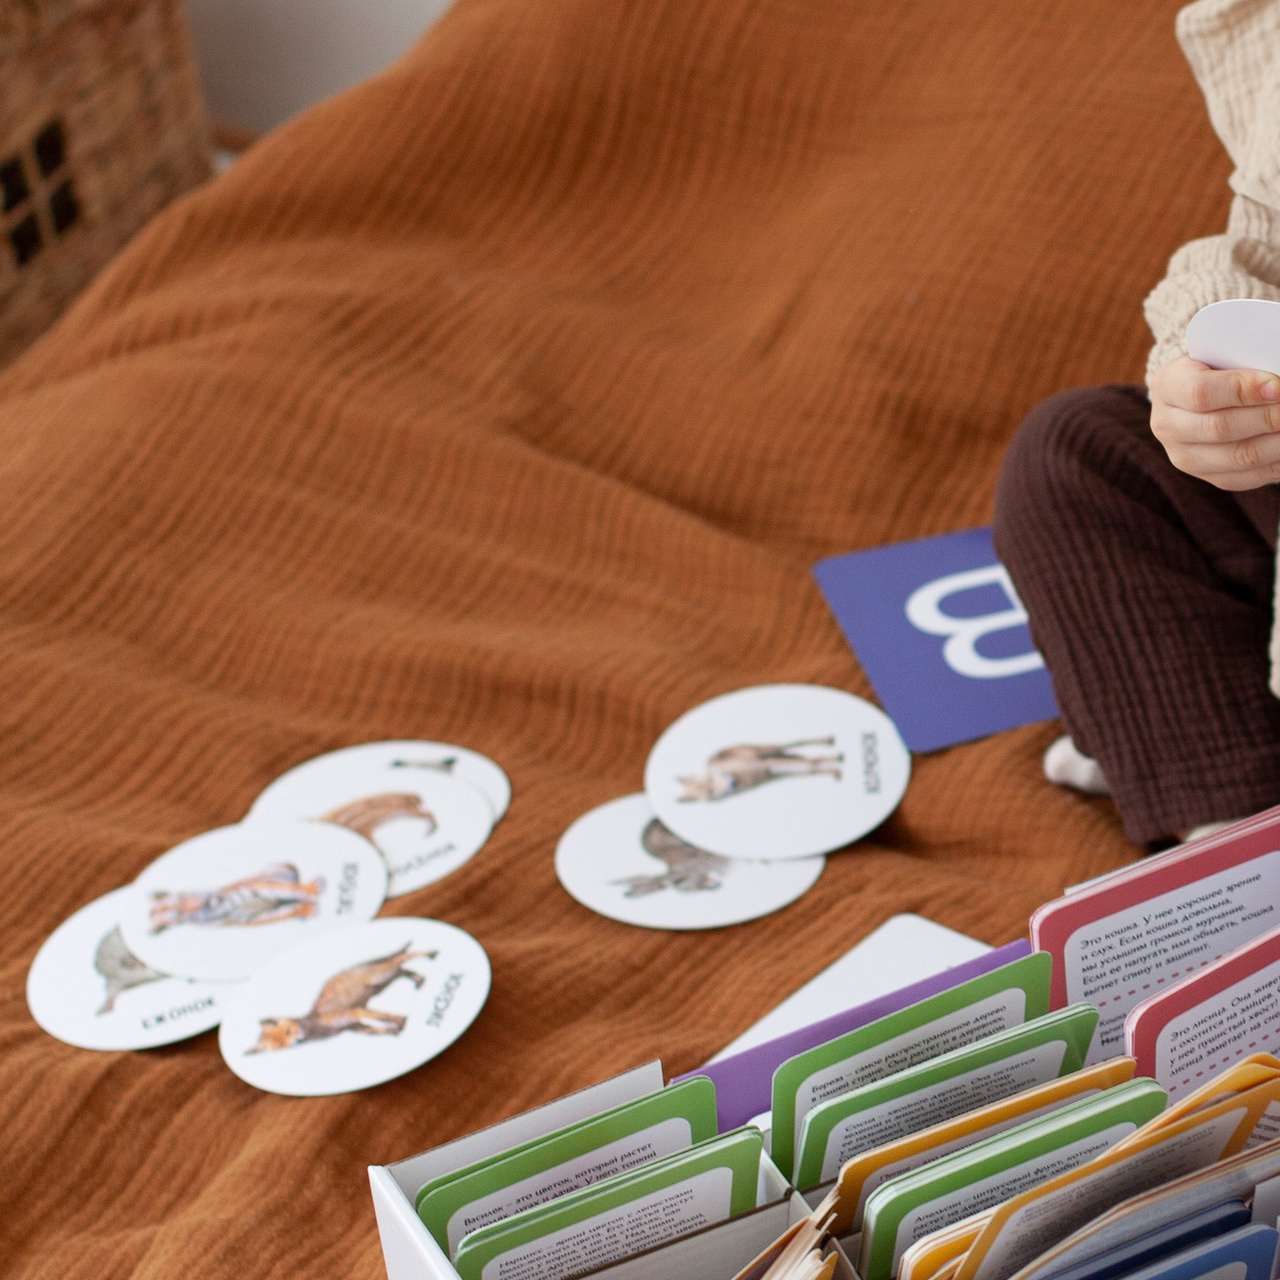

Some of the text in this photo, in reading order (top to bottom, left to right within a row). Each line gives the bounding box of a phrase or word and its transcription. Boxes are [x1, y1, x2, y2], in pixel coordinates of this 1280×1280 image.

[1081, 874, 1261, 949] Это кошка. У нее хорошее зрение
[1082, 905, 1244, 973] мы услышим громкое мурчание.
[1091, 945, 1115, 957] слух.
[1120, 933, 1142, 946] Если
[1146, 919, 1178, 935] кошка
[1182, 899, 1232, 922] довольна,
[1083, 906, 1273, 985] Если ее напугать или обидеть, кошка
[1084, 979, 1117, 997] выгнет
[1122, 966, 1151, 981] спину
[1166, 944, 1207, 964] зашипит.
[1171, 1027, 1190, 1041] Это
[1193, 1007, 1226, 1028] лисица.
[1231, 993, 1251, 1007] Она
[1255, 976, 1280, 993] живет
[1178, 1047, 1195, 1060] нее
[1198, 1018, 1245, 1049] пушистый
[1249, 999, 1278, 1019] хвост!
[1179, 1020, 1223, 1048] охотится
[1227, 1012, 1237, 1021] на
[1241, 993, 1272, 1014] зайцев.
[812, 1006, 1006, 1093] Береза самое распространенное дерево
[820, 1018, 1004, 1098] нашей стране. Она растет деревнях,
[1171, 1055, 1203, 1076] лисица
[1207, 1030, 1246, 1055] заметает
[1250, 1023, 1261, 1032] на
[464, 1144, 651, 1226] Василек это цветок, который растет
[622, 1151, 656, 1170] тонкий
[915, 1201, 961, 1223] Апельсин
[973, 1173, 1030, 1200] цитрусовый
[1067, 1141, 1108, 1164] который
[556, 1231, 585, 1246] яркий
[589, 1218, 623, 1233] цветок
[637, 1189, 693, 1214] лепестками
